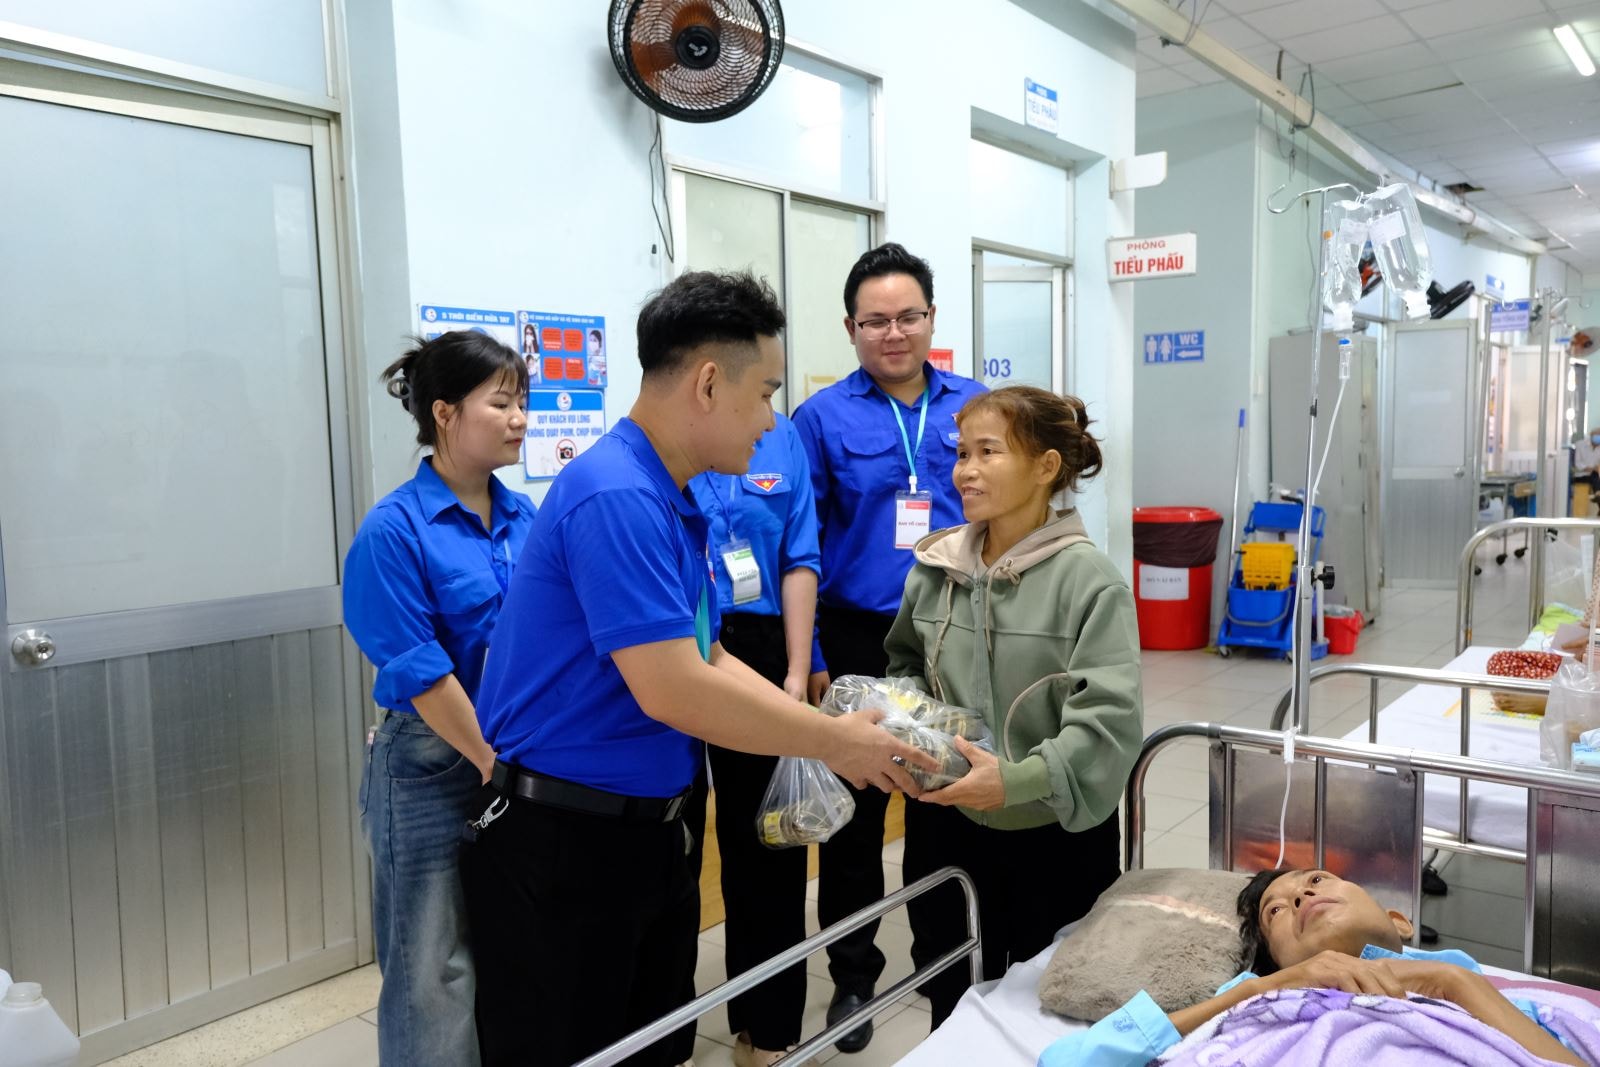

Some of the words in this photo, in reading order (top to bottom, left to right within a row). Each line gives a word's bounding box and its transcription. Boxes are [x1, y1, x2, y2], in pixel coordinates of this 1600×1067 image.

[1127, 239, 1166, 251] PHÒNG
[1114, 255, 1143, 275] TIỂU
[1147, 252, 1184, 272] PHẪU
[1179, 332, 1199, 345] WC
